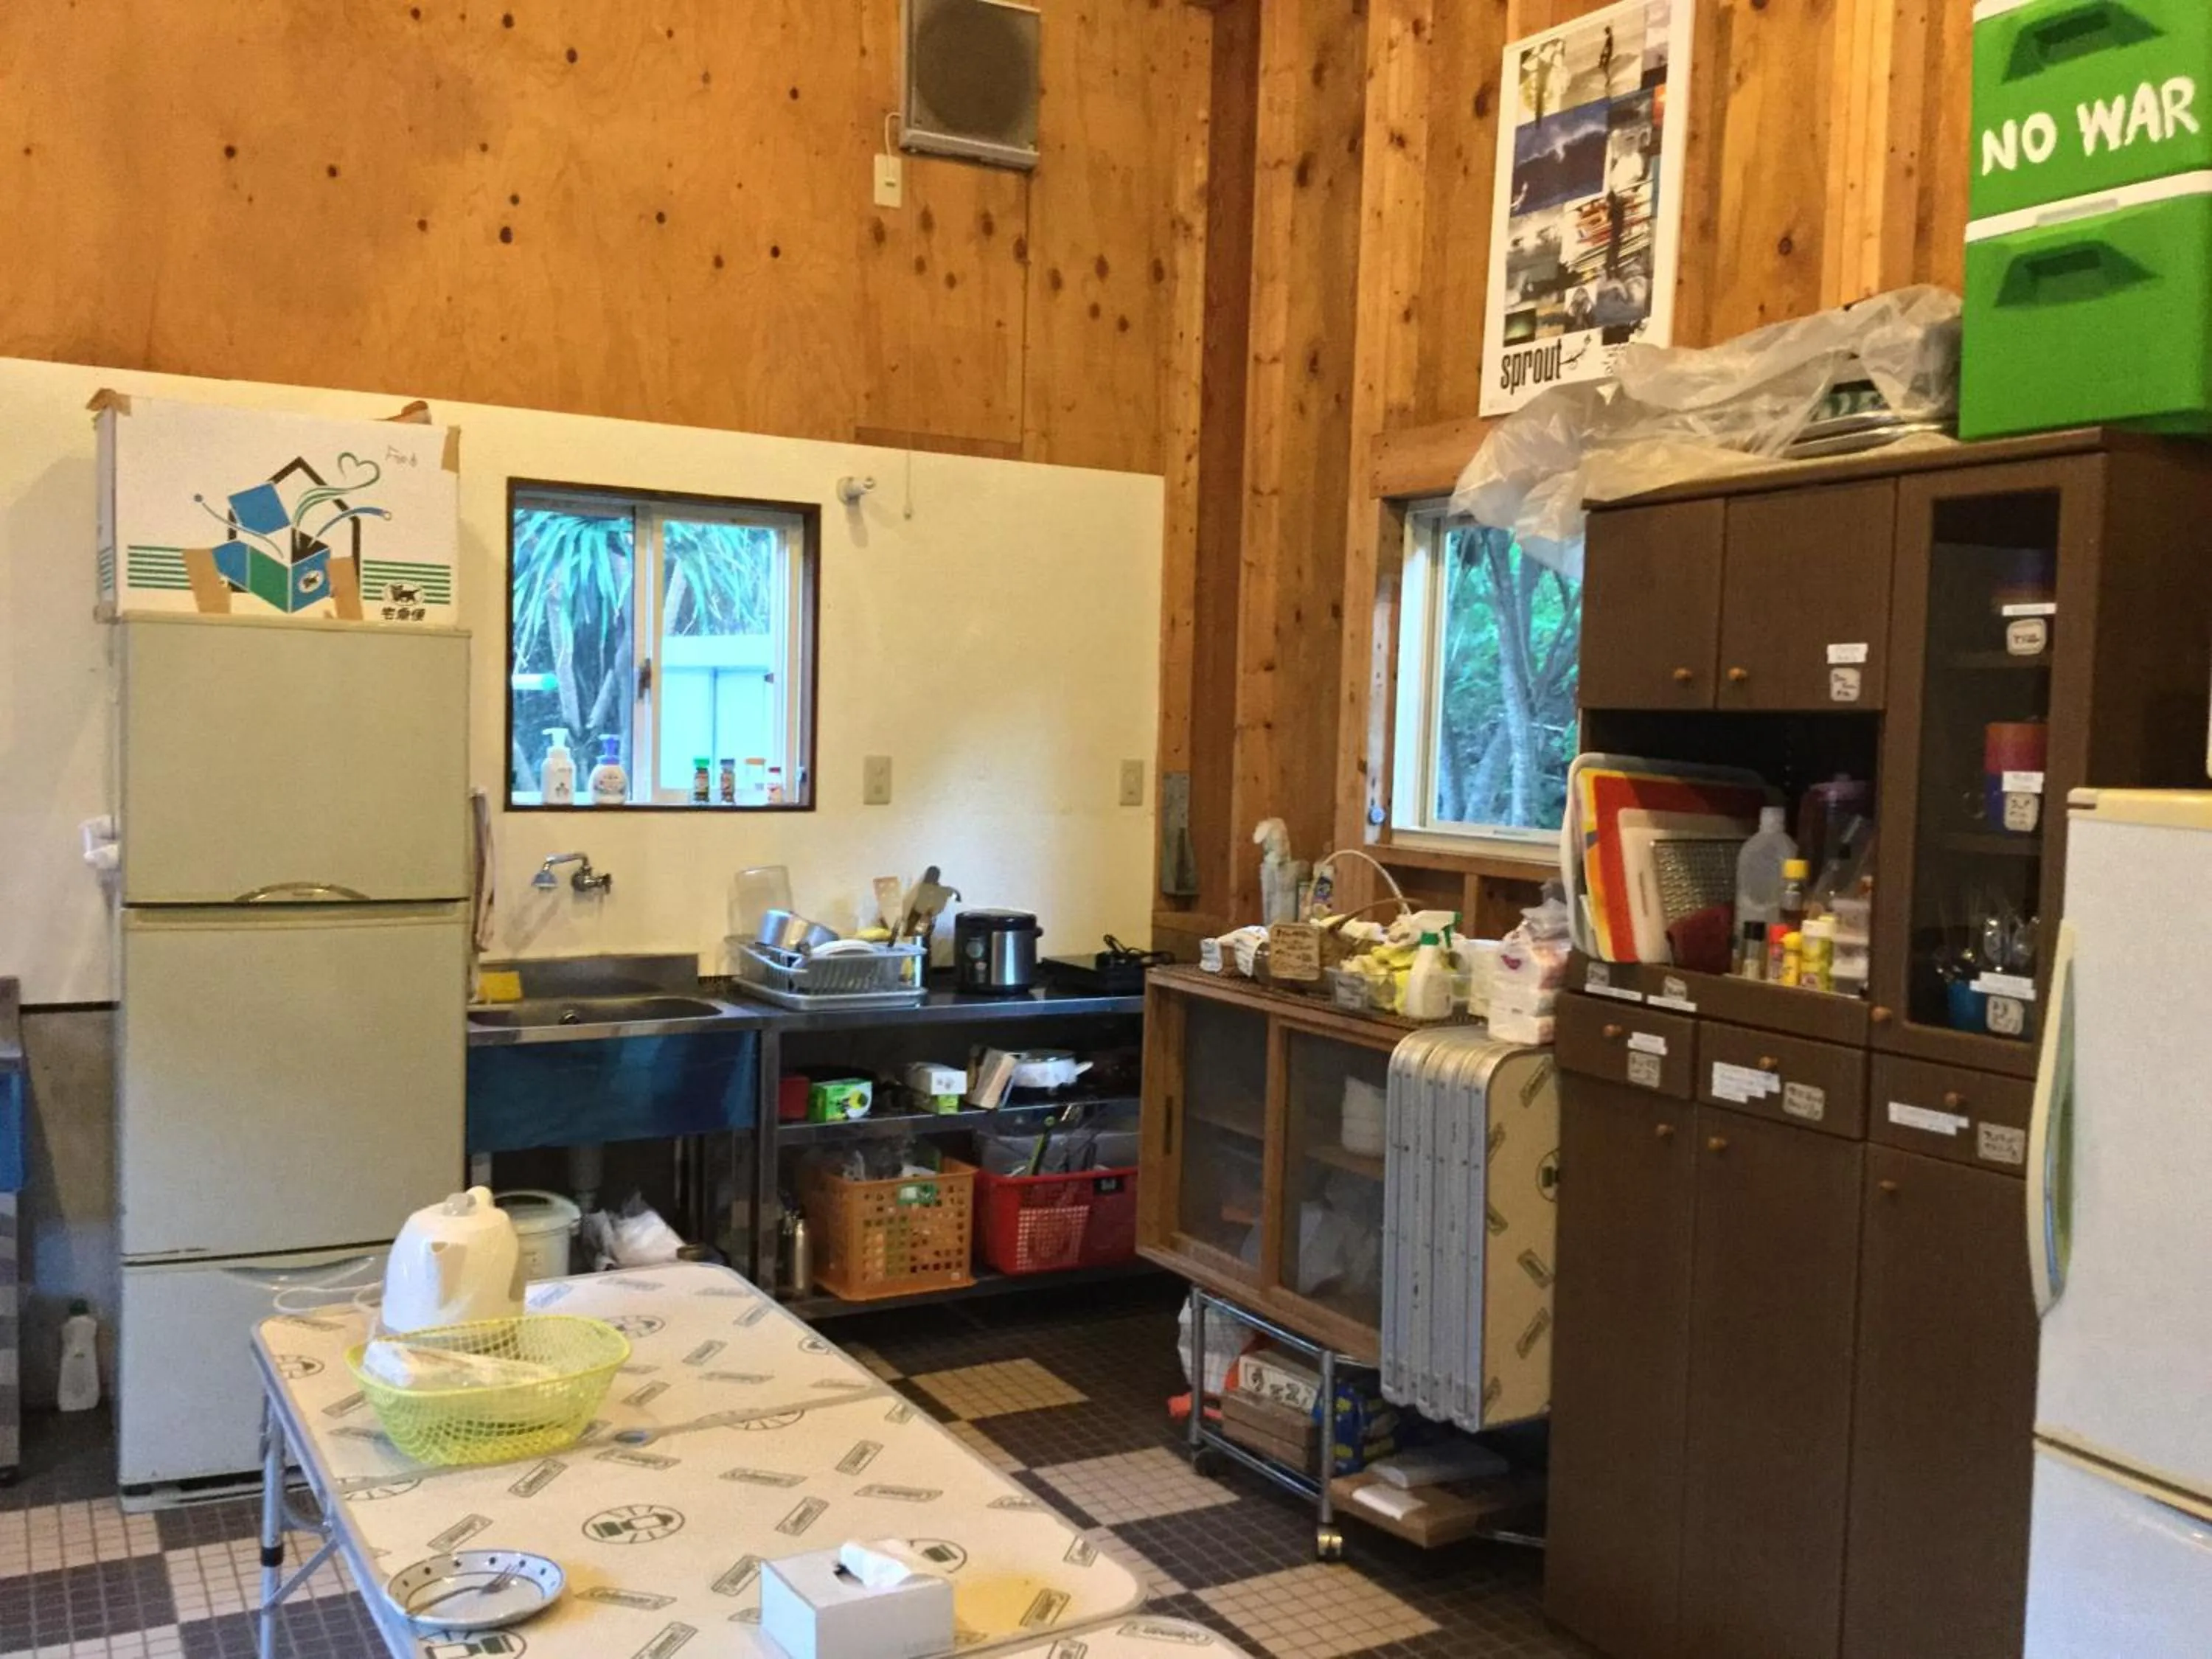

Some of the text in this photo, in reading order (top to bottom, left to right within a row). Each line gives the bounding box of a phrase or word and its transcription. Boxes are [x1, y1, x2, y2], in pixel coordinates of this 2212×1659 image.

[1981, 75, 2200, 176] NO WAR
[1500, 338, 1562, 395] sprout
